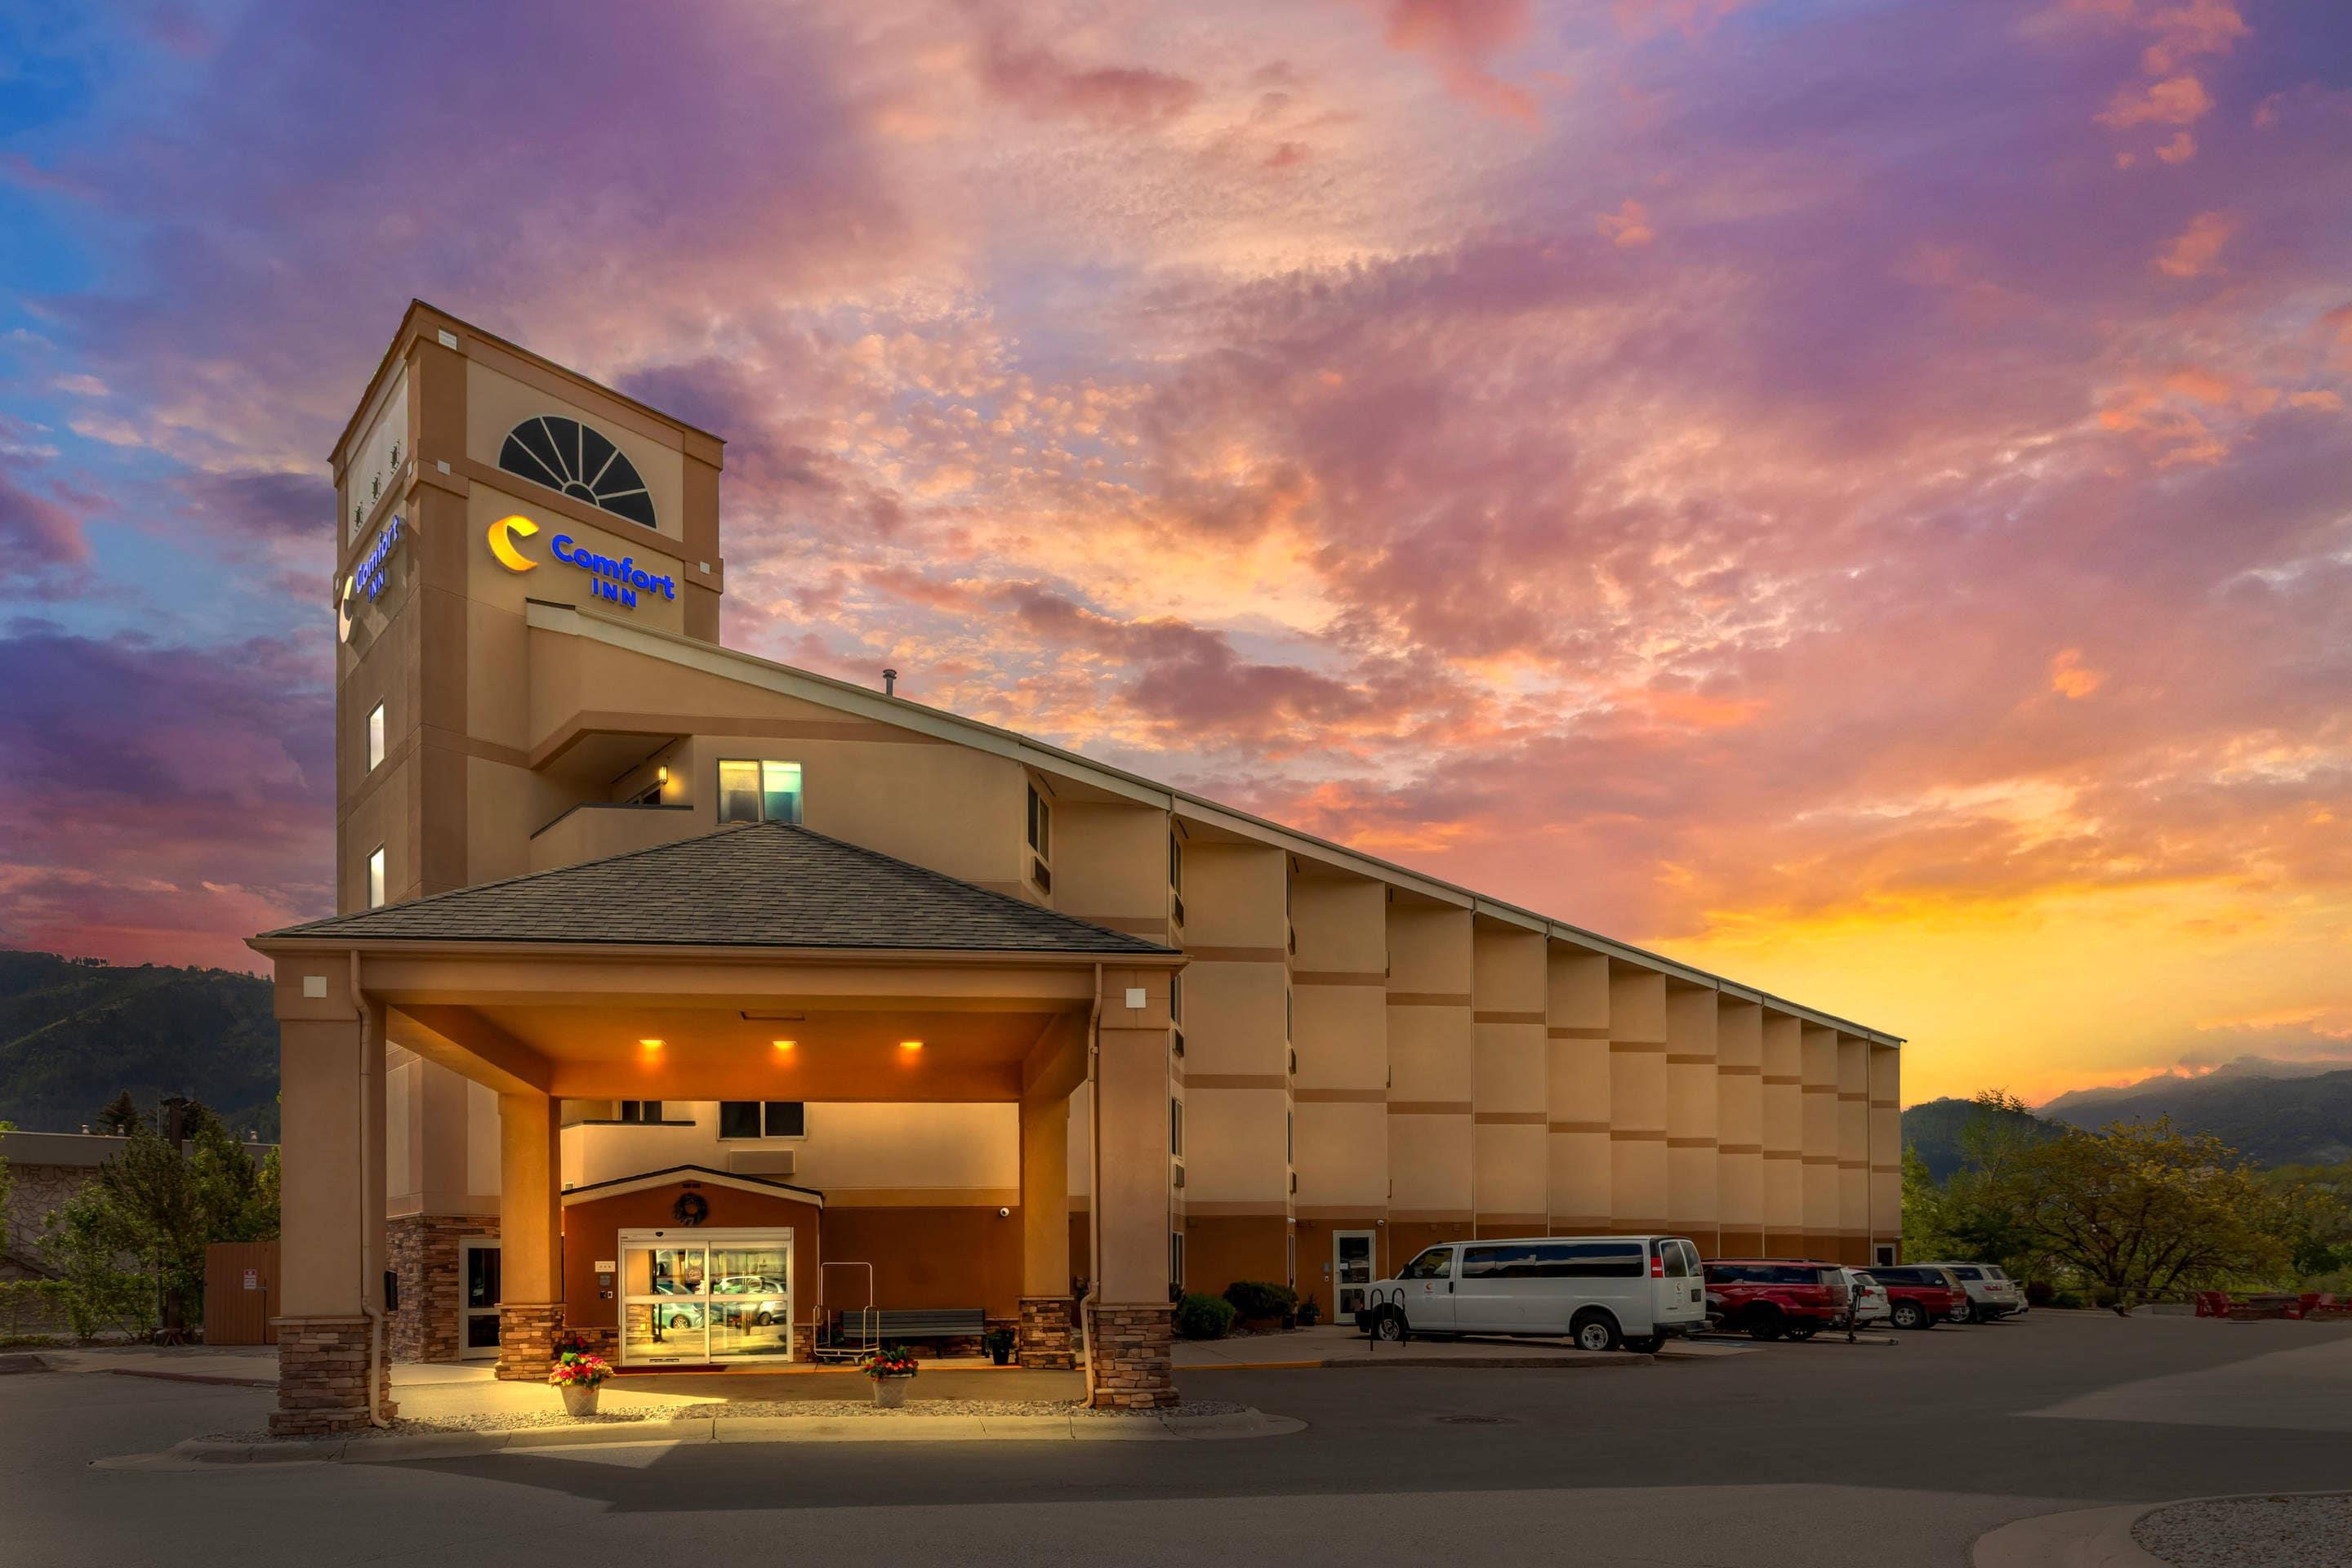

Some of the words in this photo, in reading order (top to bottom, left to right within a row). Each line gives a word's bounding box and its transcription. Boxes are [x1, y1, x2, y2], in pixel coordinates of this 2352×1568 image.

[368, 566, 385, 604] INN
[550, 534, 675, 600] Comfort
[591, 577, 637, 608] INN
